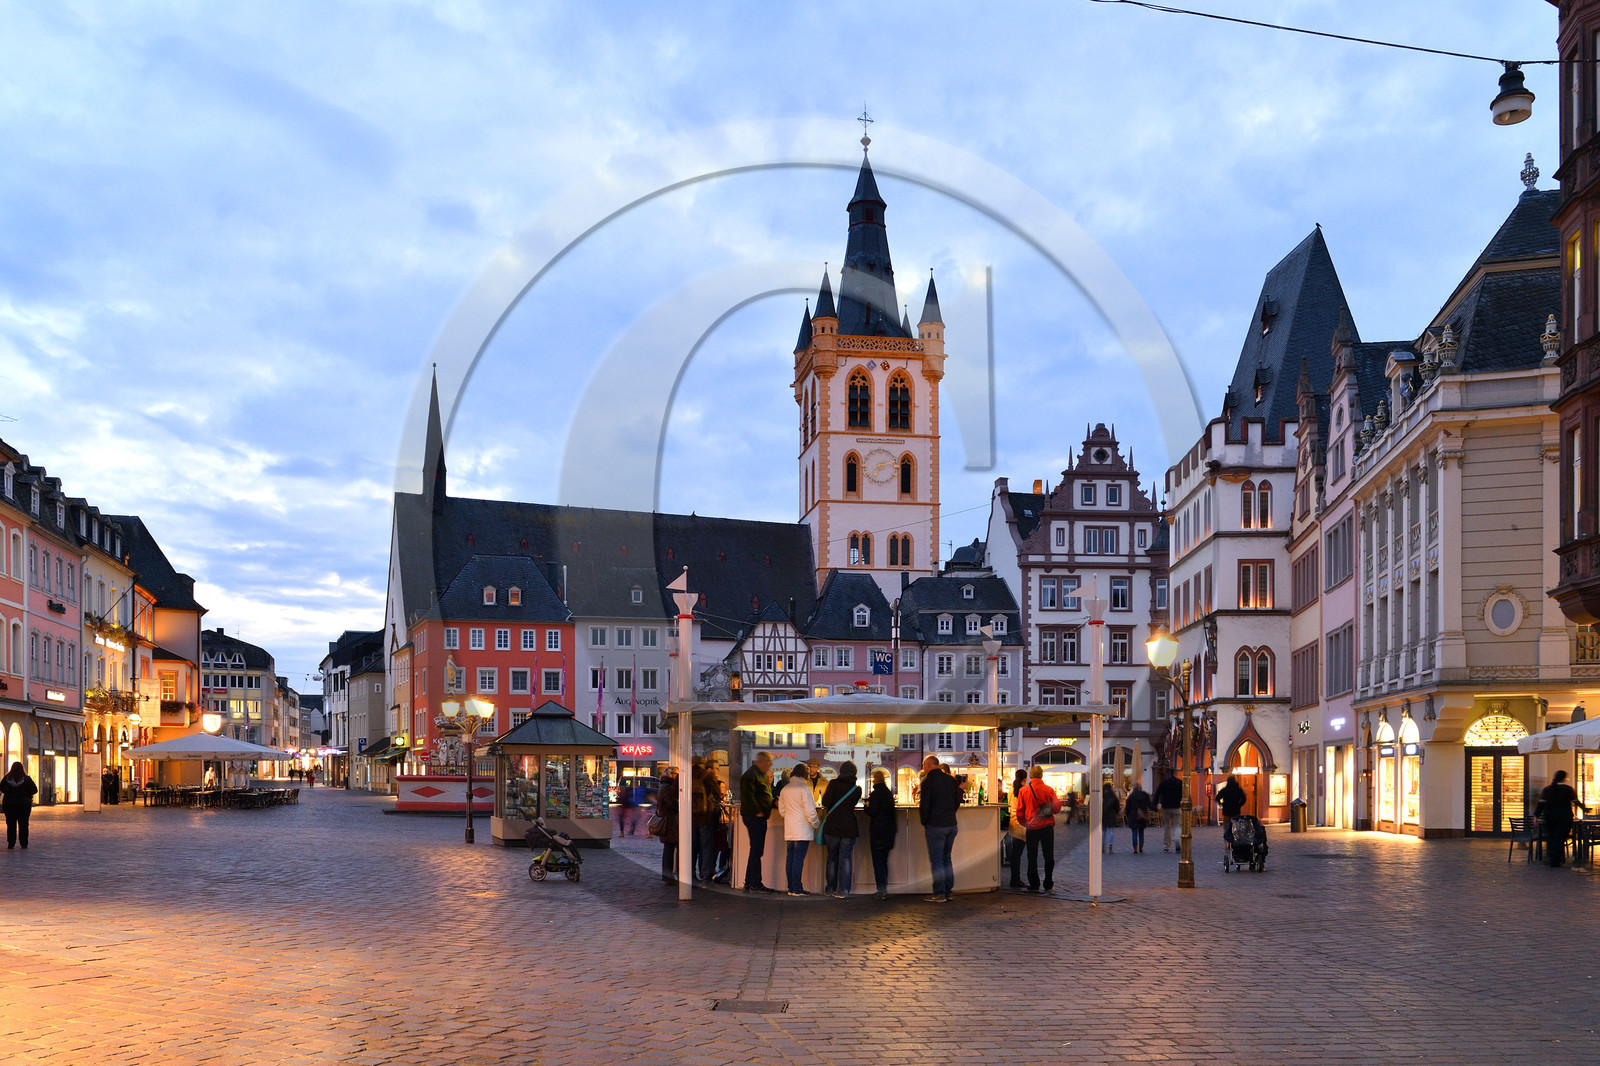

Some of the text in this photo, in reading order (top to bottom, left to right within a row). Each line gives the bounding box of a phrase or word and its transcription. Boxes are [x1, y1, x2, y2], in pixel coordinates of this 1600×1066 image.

[875, 653, 892, 662] WC
[615, 697, 660, 707] Augnoptik
[1044, 738, 1078, 746] SUBWAY
[622, 745, 652, 755] KRASS
